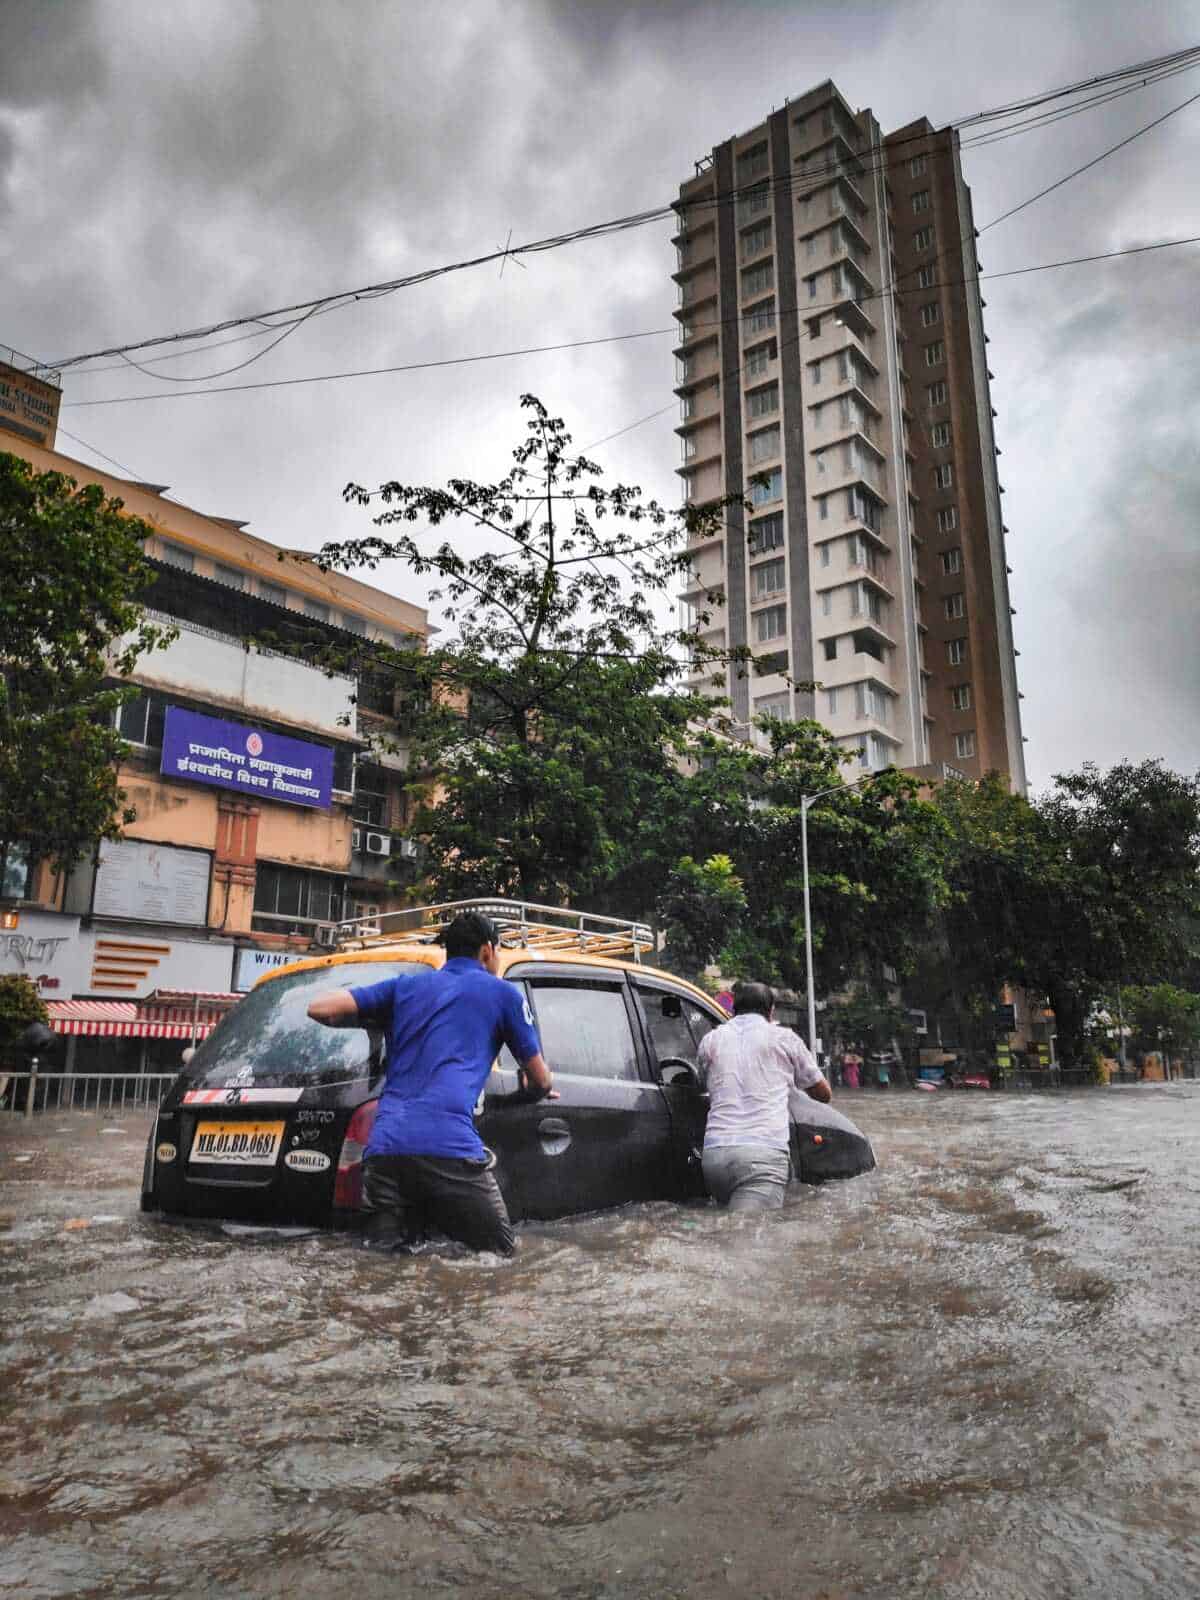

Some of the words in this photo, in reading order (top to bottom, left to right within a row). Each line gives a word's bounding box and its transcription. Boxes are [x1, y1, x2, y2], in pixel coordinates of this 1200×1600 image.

[177, 757, 233, 781] ईश्वरीय
[237, 769, 269, 788] विश्व
[272, 777, 321, 799] विद्यालय
[188, 743, 246, 766] प्रजापिता
[249, 758, 313, 781] ब्रह्माकुमारी
